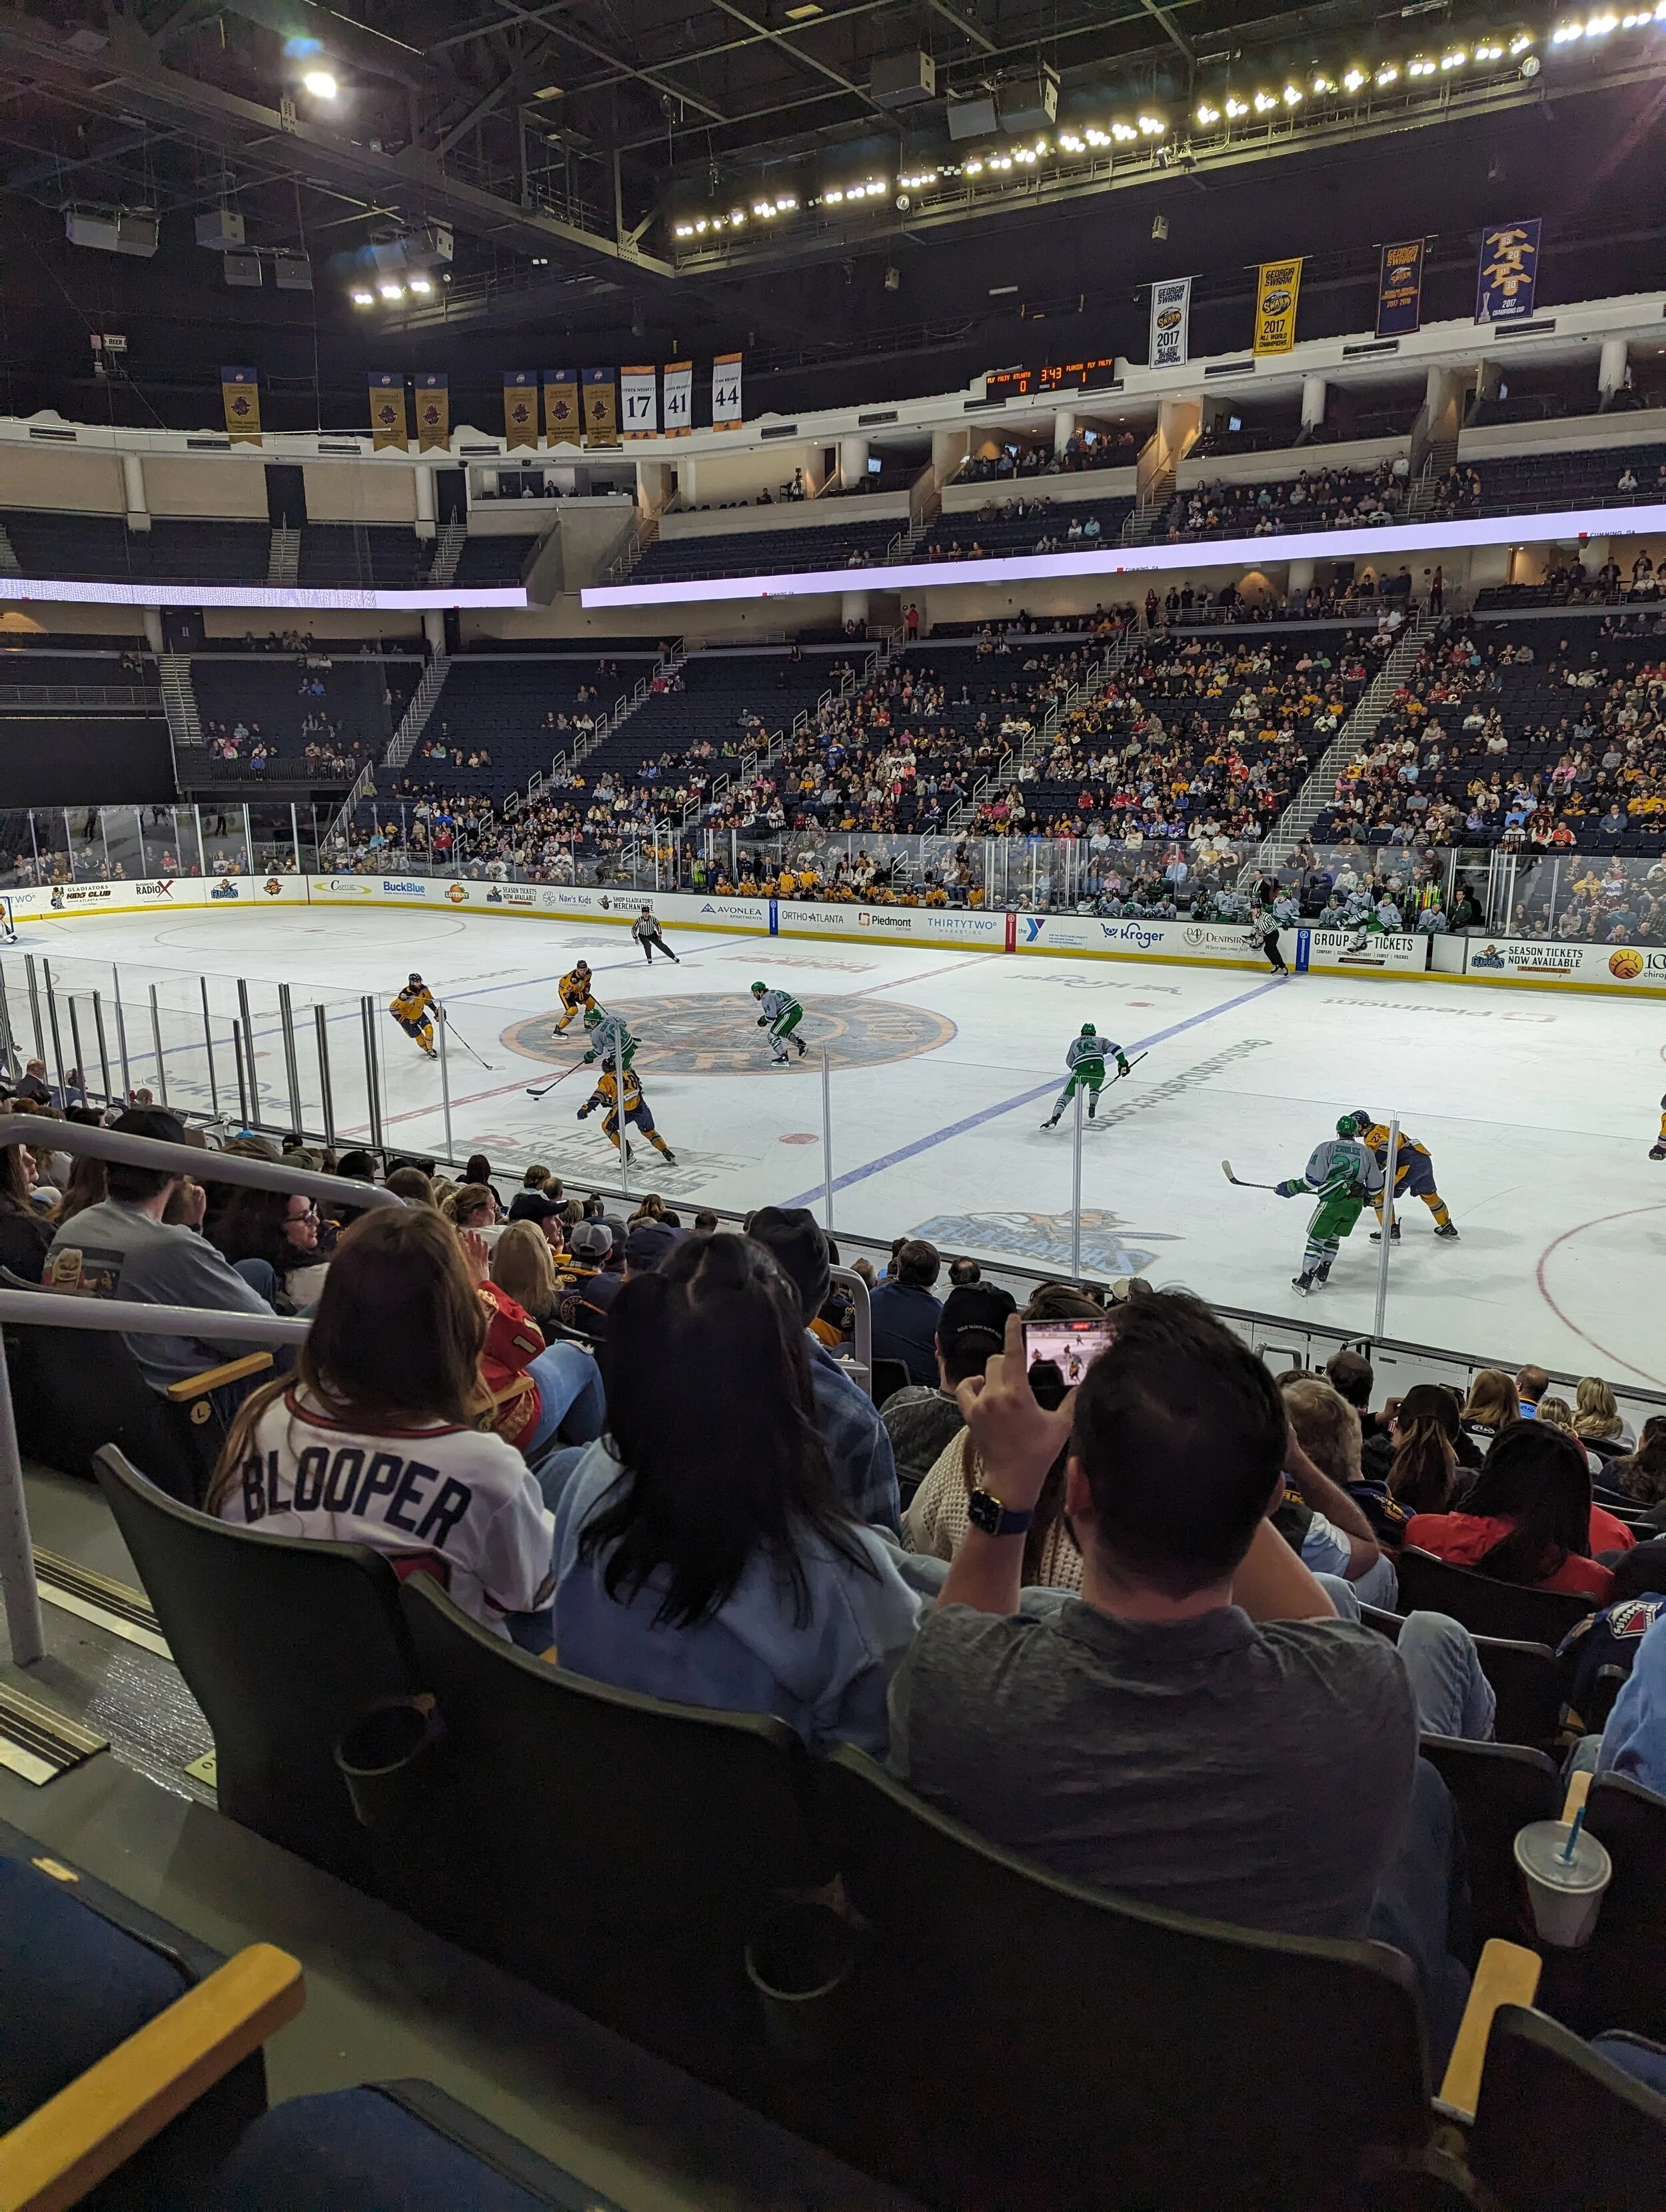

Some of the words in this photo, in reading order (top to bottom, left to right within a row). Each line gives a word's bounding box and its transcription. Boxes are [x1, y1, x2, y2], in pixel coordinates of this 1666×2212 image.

[1267, 267, 1294, 279] GEORGIA
[1265, 276, 1292, 286] SWARM
[1158, 285, 1185, 296] GEORGIA
[1158, 294, 1183, 304] SWARM
[1263, 295, 1291, 314] SWARM
[1501, 298, 1516, 308] 2017
[1158, 312, 1182, 327] SWARM
[1264, 319, 1285, 333] 2017
[1157, 330, 1180, 347] 2017
[1041, 367, 1062, 381] 3:43
[1020, 381, 1026, 392] 0
[1082, 372, 1086, 382] 1
[715, 385, 739, 406] 44
[626, 396, 651, 418] 17
[668, 392, 687, 414] 41
[383, 881, 425, 893] BuckBlue
[558, 893, 576, 903] Nan's
[578, 895, 592, 904] Kids
[717, 906, 762, 915] AVONLEA
[782, 910, 808, 921] ORTHO
[808, 912, 844, 923] ATLANTA
[872, 915, 912, 927] Piedmont
[1121, 922, 1164, 949] Kroger
[1314, 933, 1349, 947] GROUP
[1375, 936, 1413, 951] TICKETS
[1509, 946, 1543, 955] SEASON
[1546, 948, 1583, 958] TICKETS
[1472, 956, 1505, 968] GLADIATORS
[1508, 955, 1529, 965] NOW
[1533, 957, 1581, 967] AVAILABLE
[1645, 953, 1666, 969] 10
[1320, 997, 1493, 1017] Piedmont
[1329, 1155, 1361, 1181] 21
[242, 1446, 472, 1549] BLOOPER
